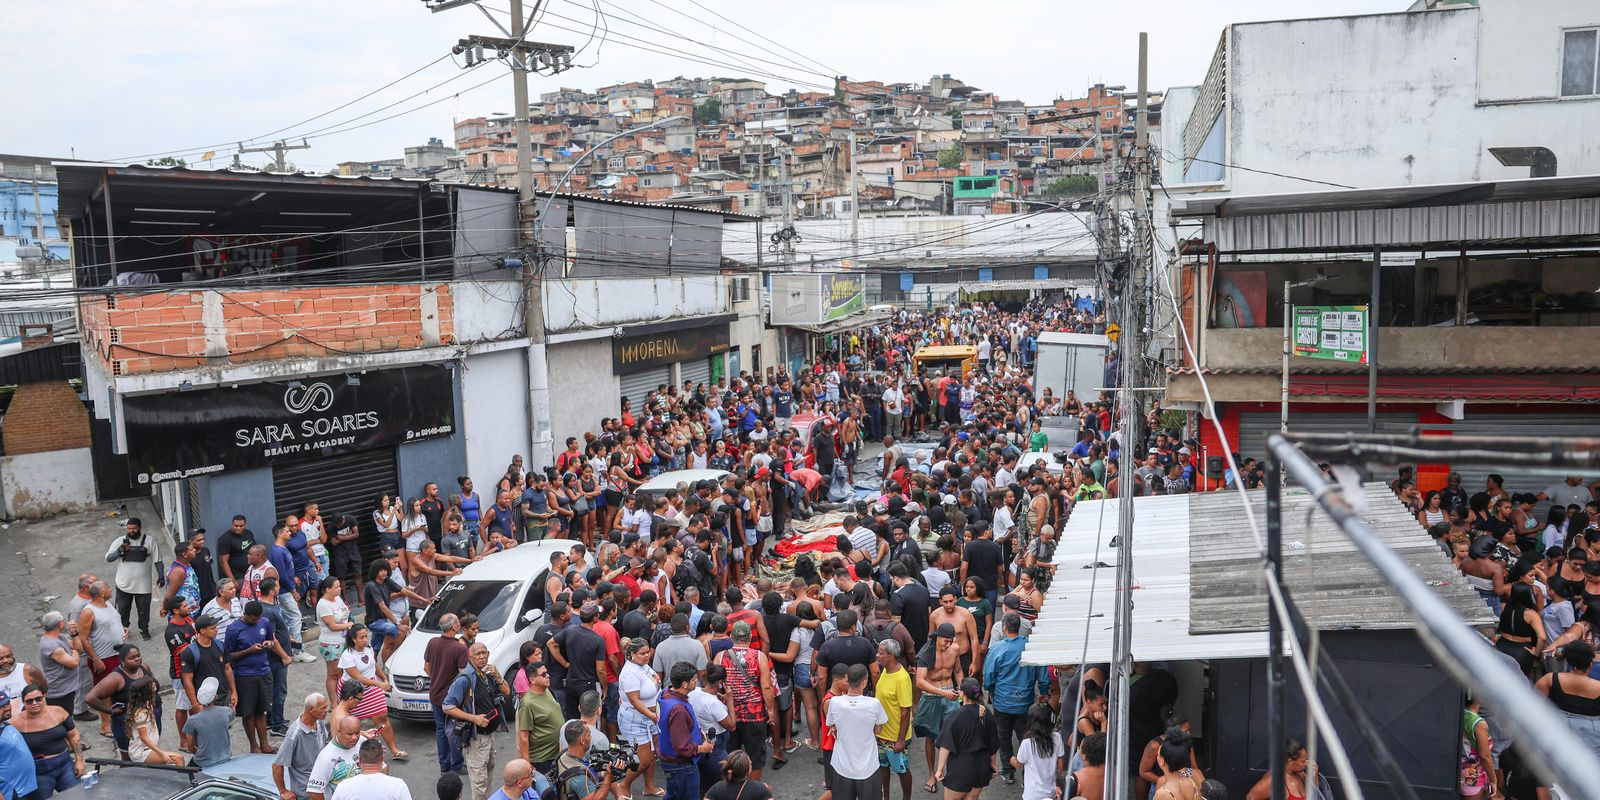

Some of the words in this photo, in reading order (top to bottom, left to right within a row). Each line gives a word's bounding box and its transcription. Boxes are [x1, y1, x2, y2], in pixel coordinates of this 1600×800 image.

[1297, 327, 1318, 345] CRISTO
[235, 423, 295, 447] SARA
[300, 411, 379, 437] SOARES
[264, 444, 301, 457] BEAUTY
[312, 435, 356, 449] ACADEMY
